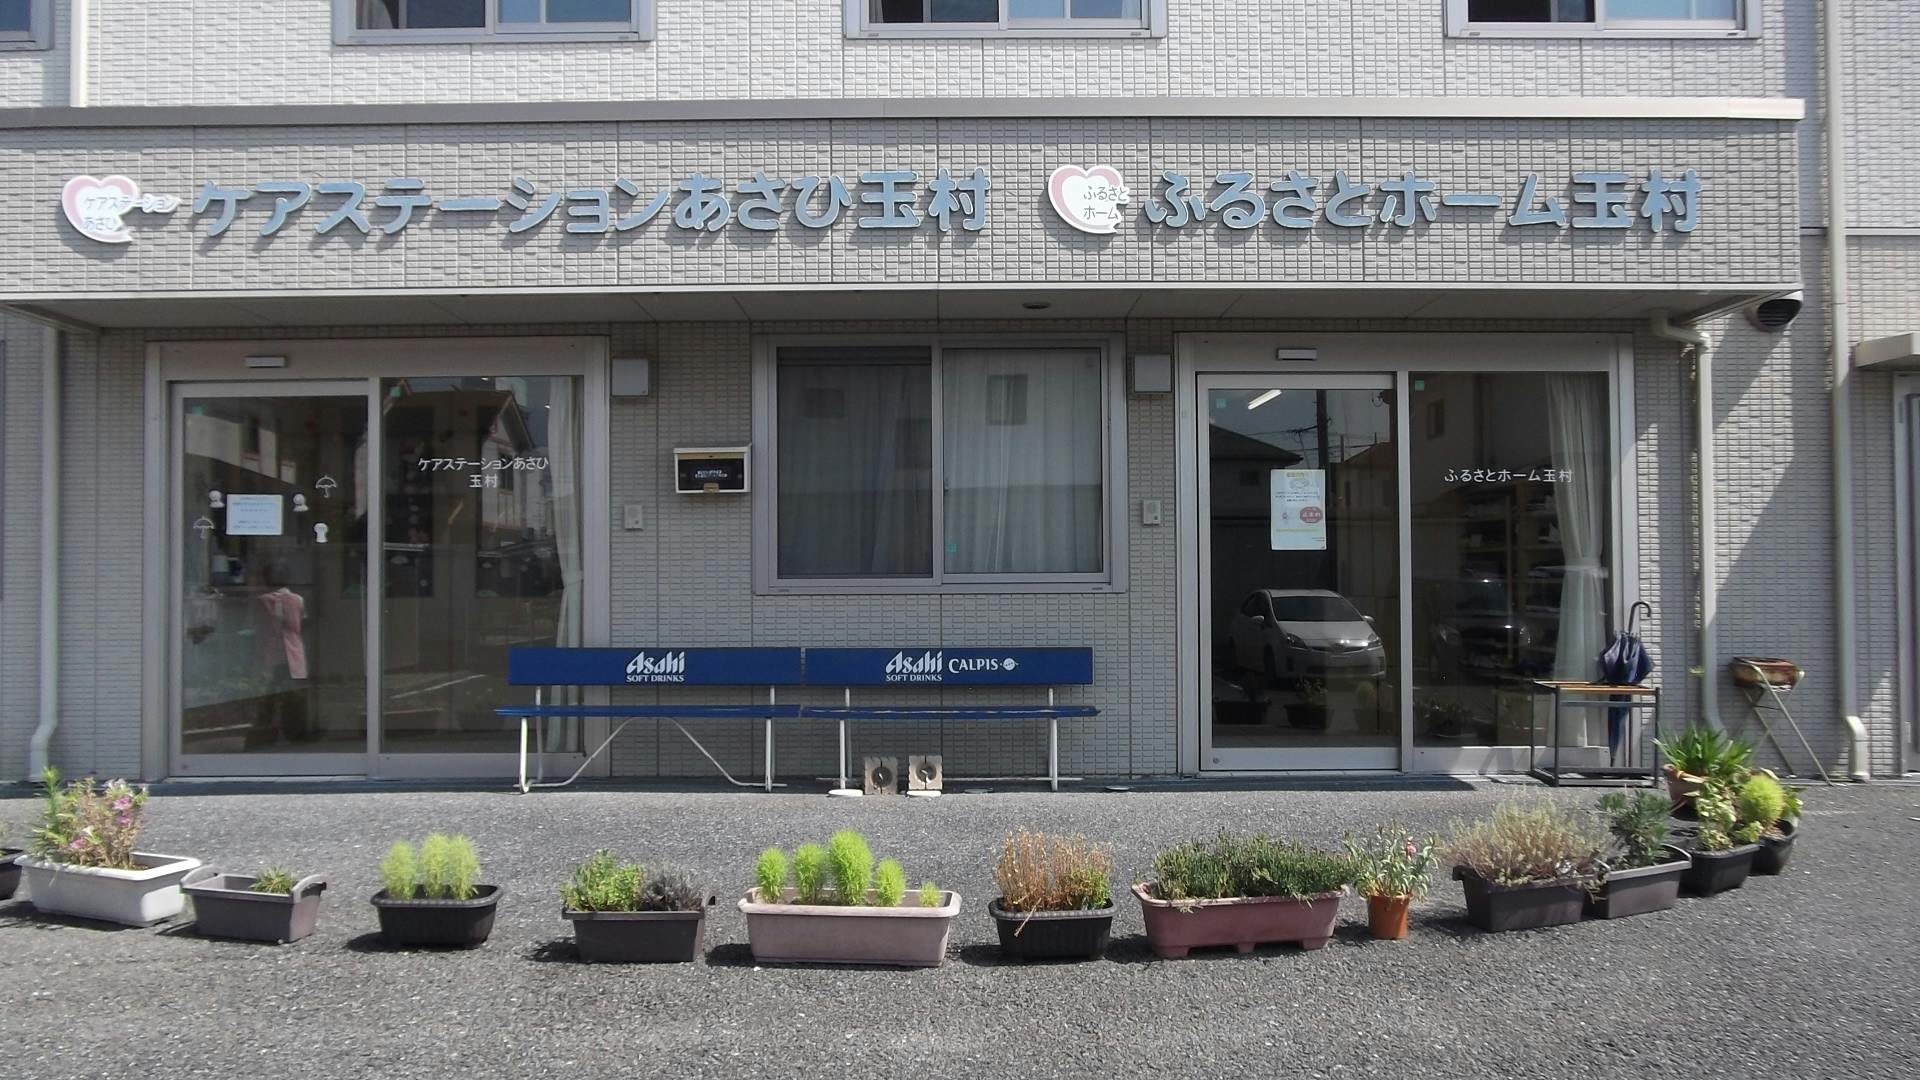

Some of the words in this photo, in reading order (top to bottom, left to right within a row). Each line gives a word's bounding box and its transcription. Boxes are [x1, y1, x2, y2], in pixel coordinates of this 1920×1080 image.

[1083, 186, 1128, 202] ふるさと
[1144, 168, 1702, 233] ふるさとホーム玉村
[85, 195, 178, 211] ケアステーション
[193, 167, 991, 237] ケアステーションあさひ玉村
[1083, 205, 1119, 220] ホーム
[84, 217, 120, 231] あさひ
[417, 457, 549, 471] ケアステーションあさひ
[469, 474, 498, 488] 玉村
[1444, 468, 1573, 483] ふるさとホーム玉村
[626, 651, 685, 674] Asahi
[885, 651, 943, 674] Asahi
[948, 658, 999, 673] CALPIS
[626, 674, 649, 682] SOFT
[650, 674, 684, 682] DRINKS
[886, 674, 908, 682] SOFT
[909, 674, 942, 682] DRINKS
